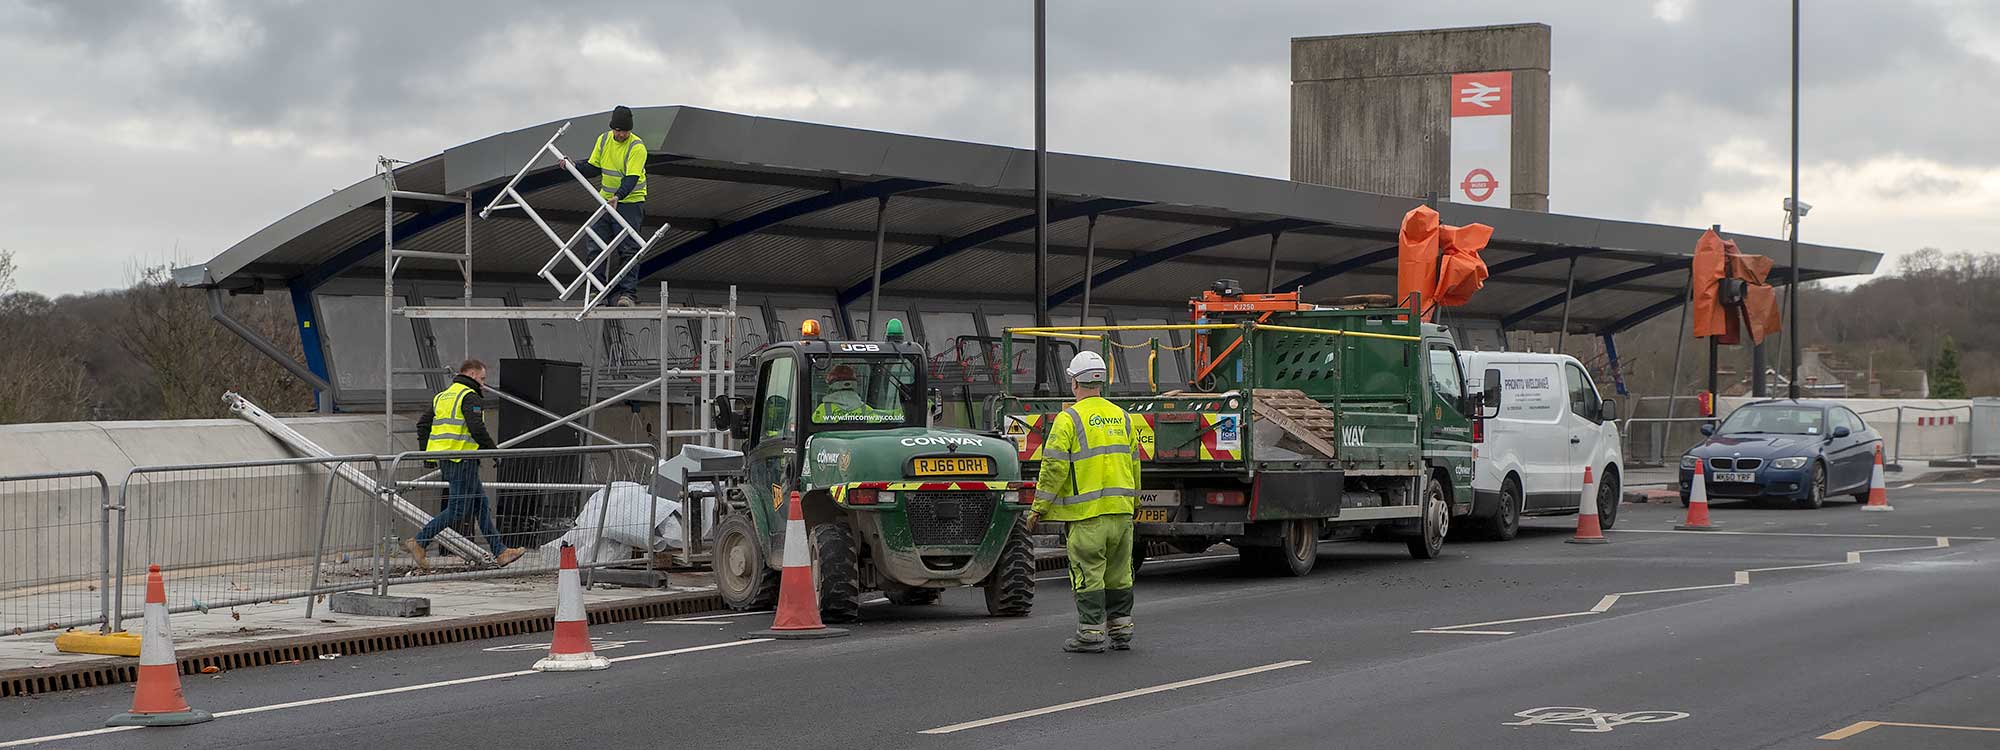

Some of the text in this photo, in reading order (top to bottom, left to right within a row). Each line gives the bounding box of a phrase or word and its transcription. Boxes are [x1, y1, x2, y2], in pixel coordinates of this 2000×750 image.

[841, 344, 880, 352] JCB
[822, 412, 905, 423] www.fmconway.co.uk
[1089, 413, 1123, 428] CONWAY
[1341, 425, 1367, 446] WAY
[900, 436, 983, 447] CONWAY
[920, 459, 955, 473] RJ66
[1145, 510, 1166, 520] PBF
